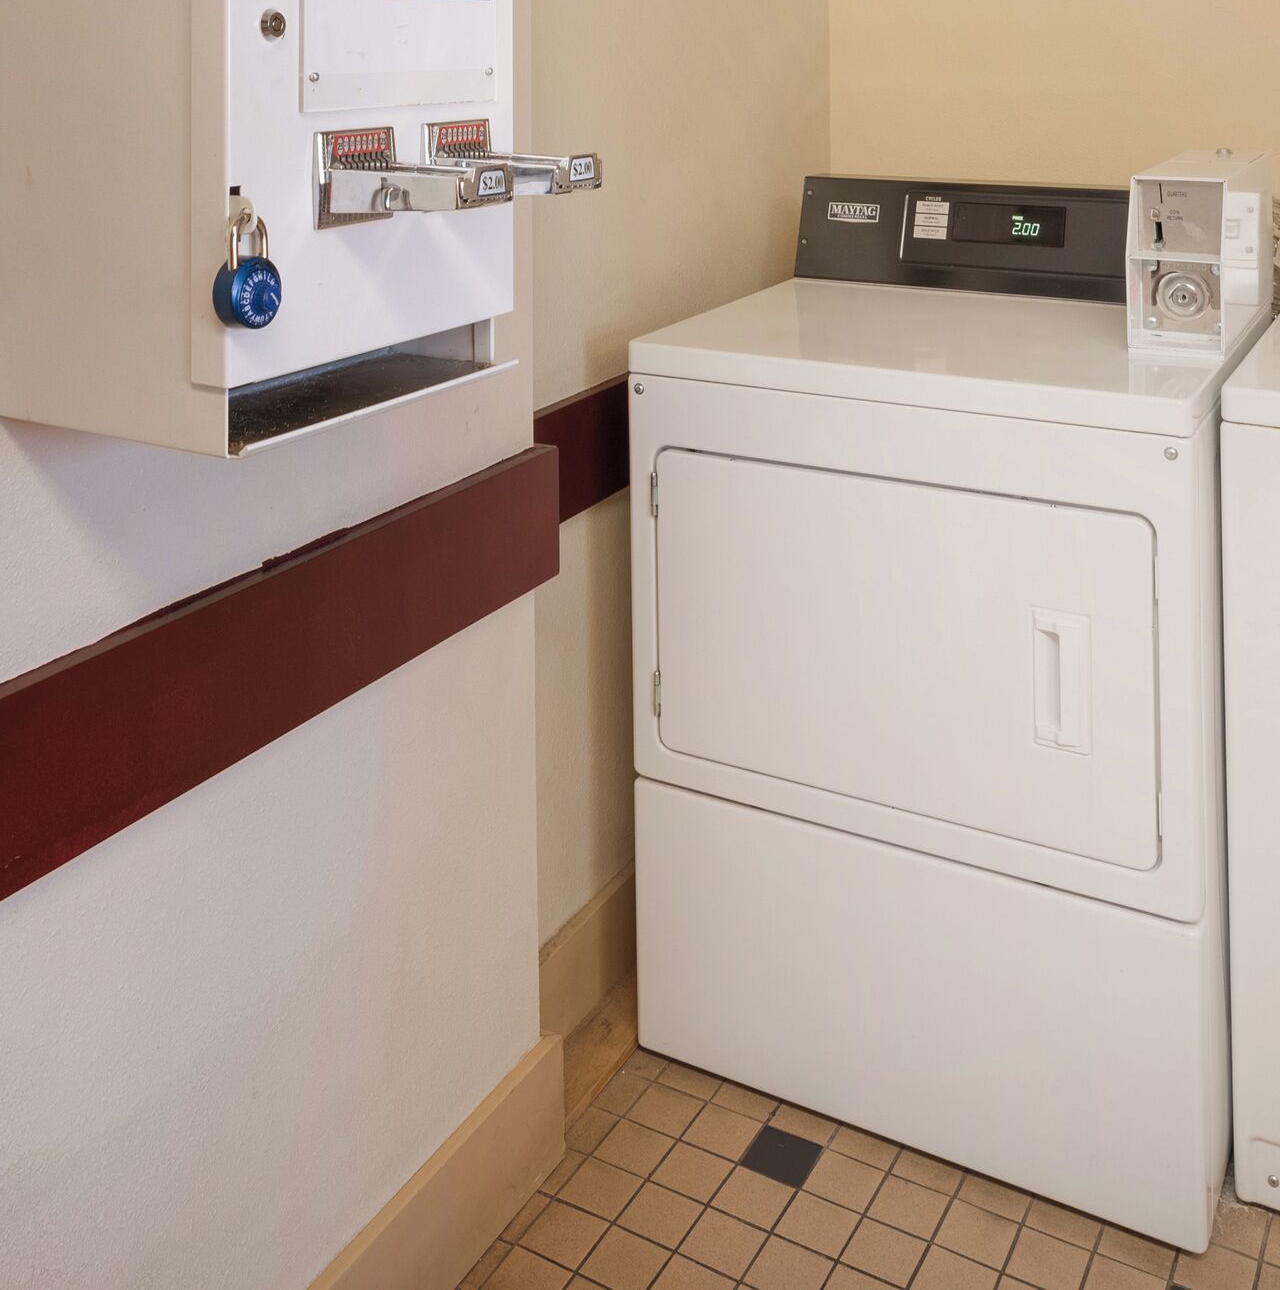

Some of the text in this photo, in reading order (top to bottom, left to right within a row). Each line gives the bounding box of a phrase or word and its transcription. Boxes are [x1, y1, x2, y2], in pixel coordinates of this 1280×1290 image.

[573, 162, 592, 179] $2.00
[482, 175, 505, 192] $2.00
[831, 204, 877, 216] MAYTAG
[1011, 222, 1040, 236] 2.00
